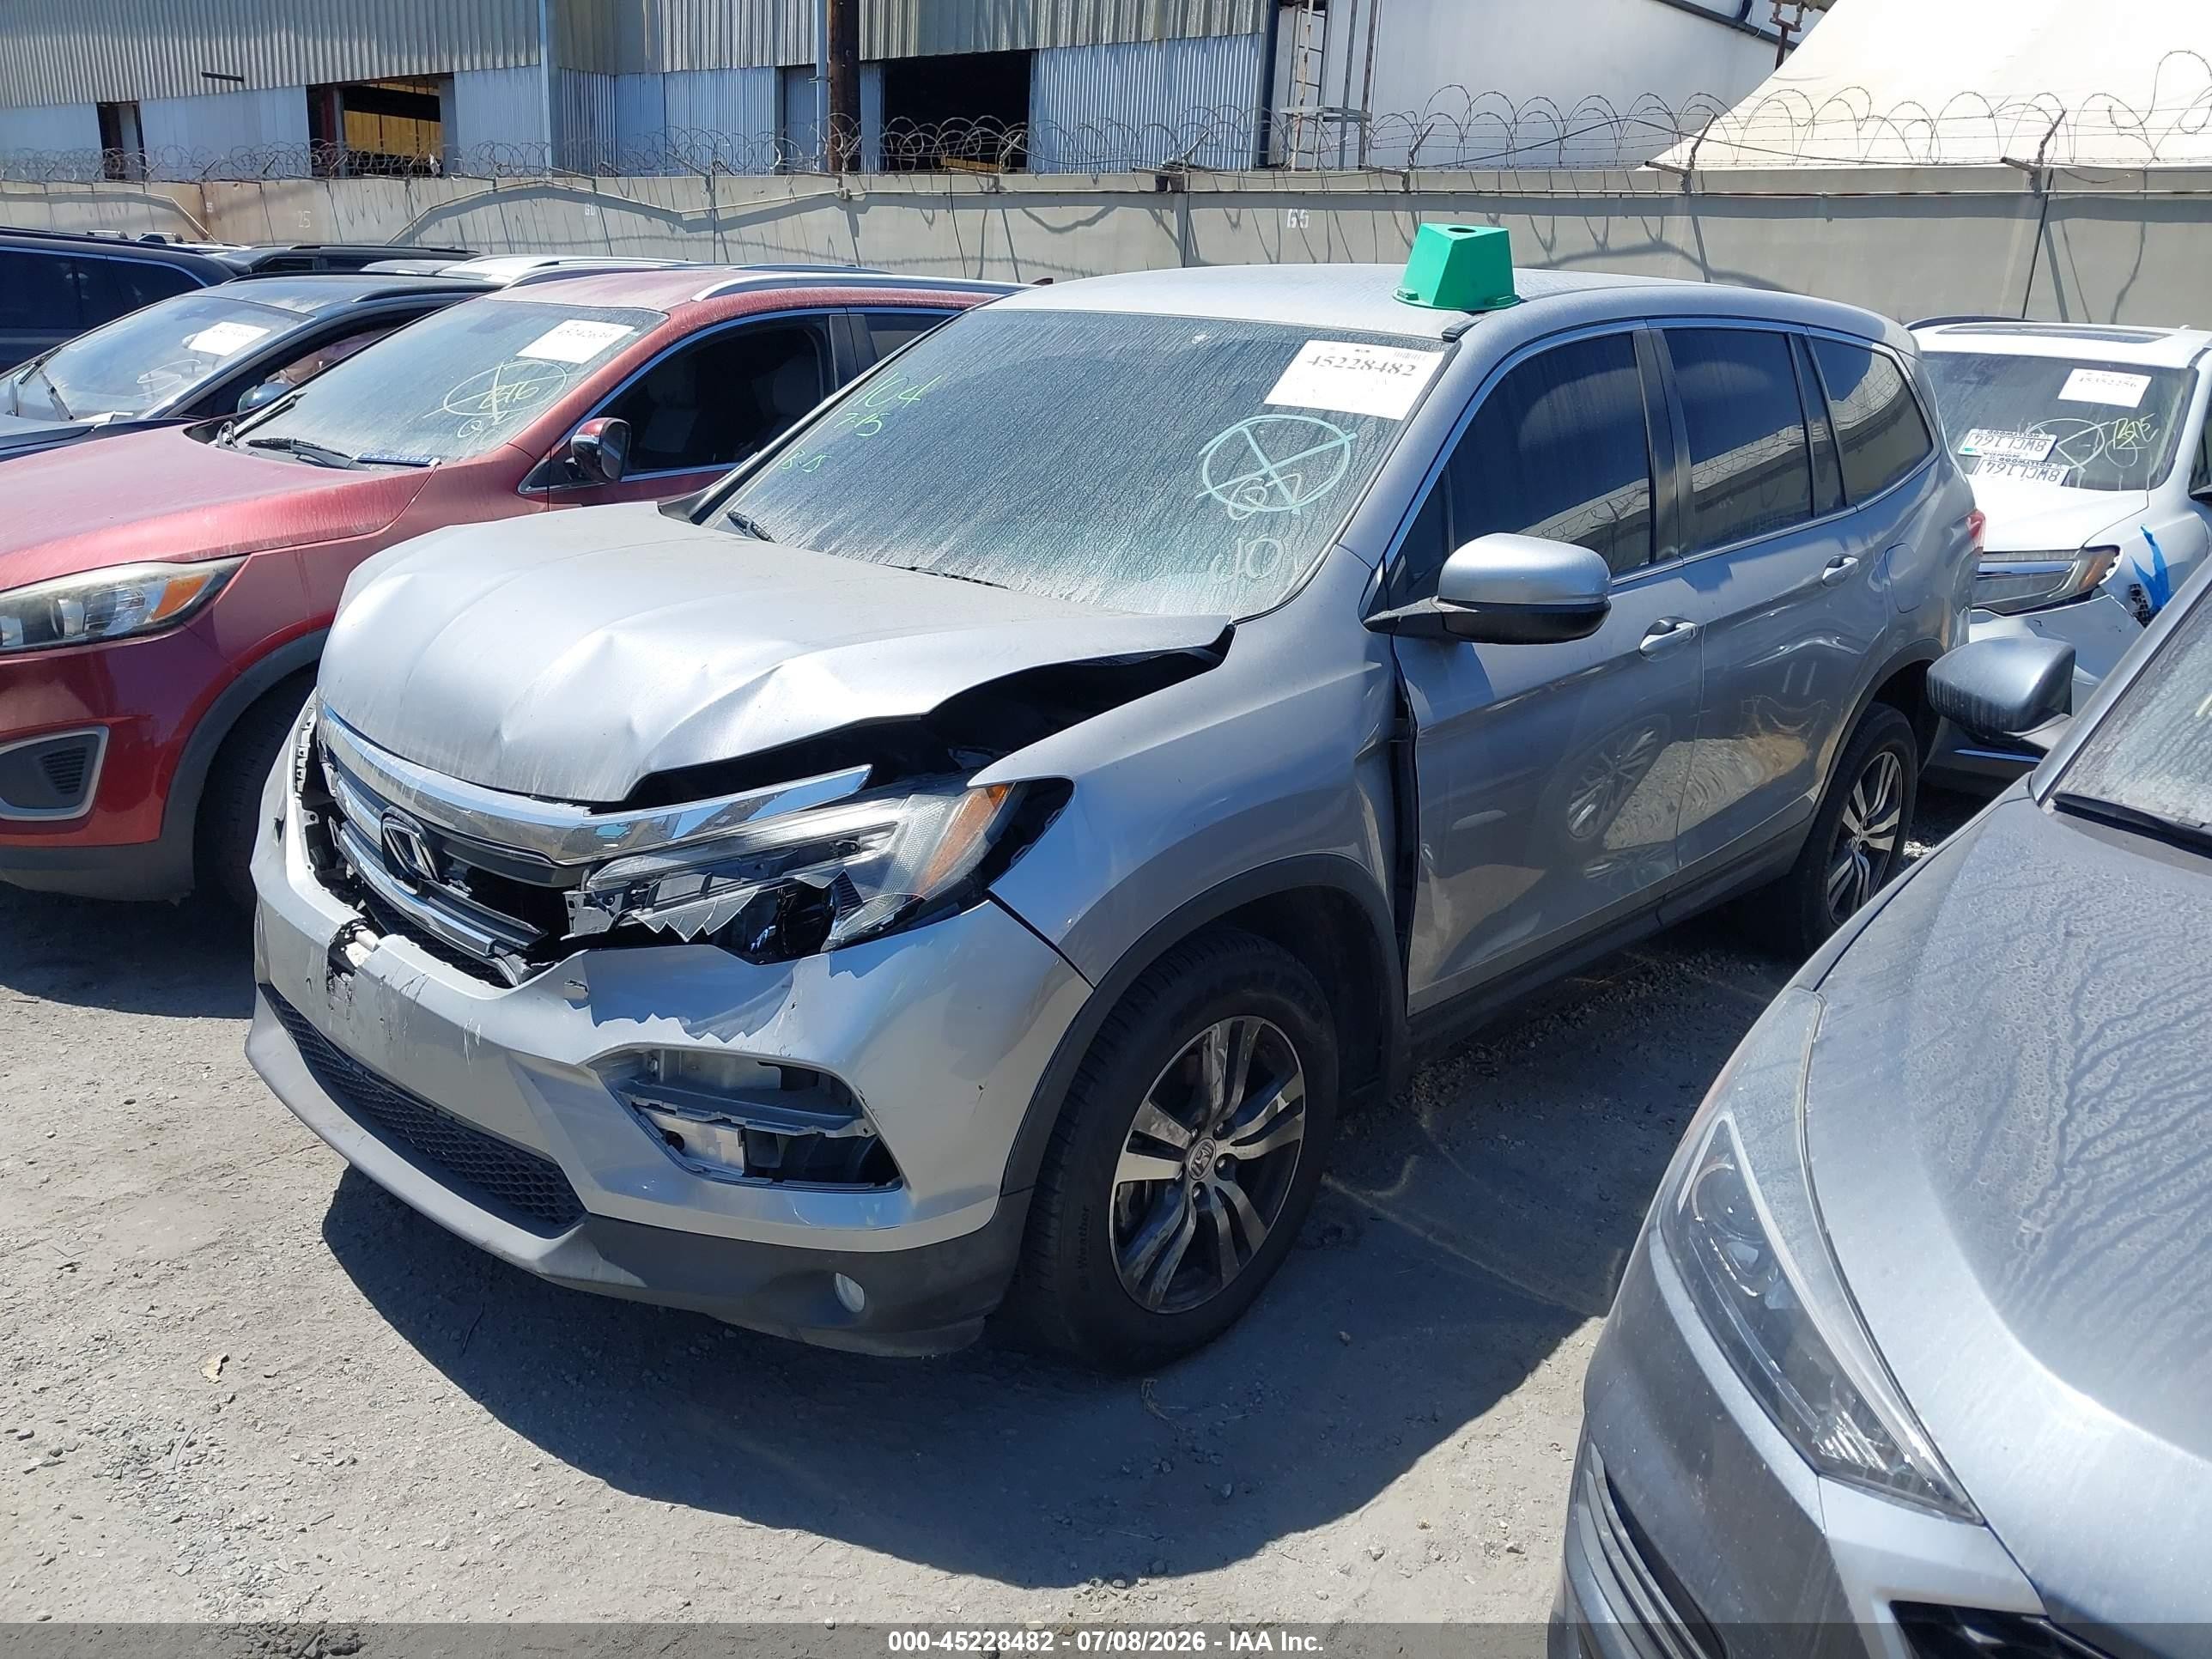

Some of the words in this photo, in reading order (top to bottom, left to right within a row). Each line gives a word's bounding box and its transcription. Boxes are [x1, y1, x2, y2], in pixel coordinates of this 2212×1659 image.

[297, 210, 312, 228] 25
[1306, 355, 1417, 377] 45228482
[1974, 434, 2047, 453] 8WCL164
[1986, 461, 2061, 483] 8WCL164
[1998, 457, 2053, 468] HOLLYWOOD
